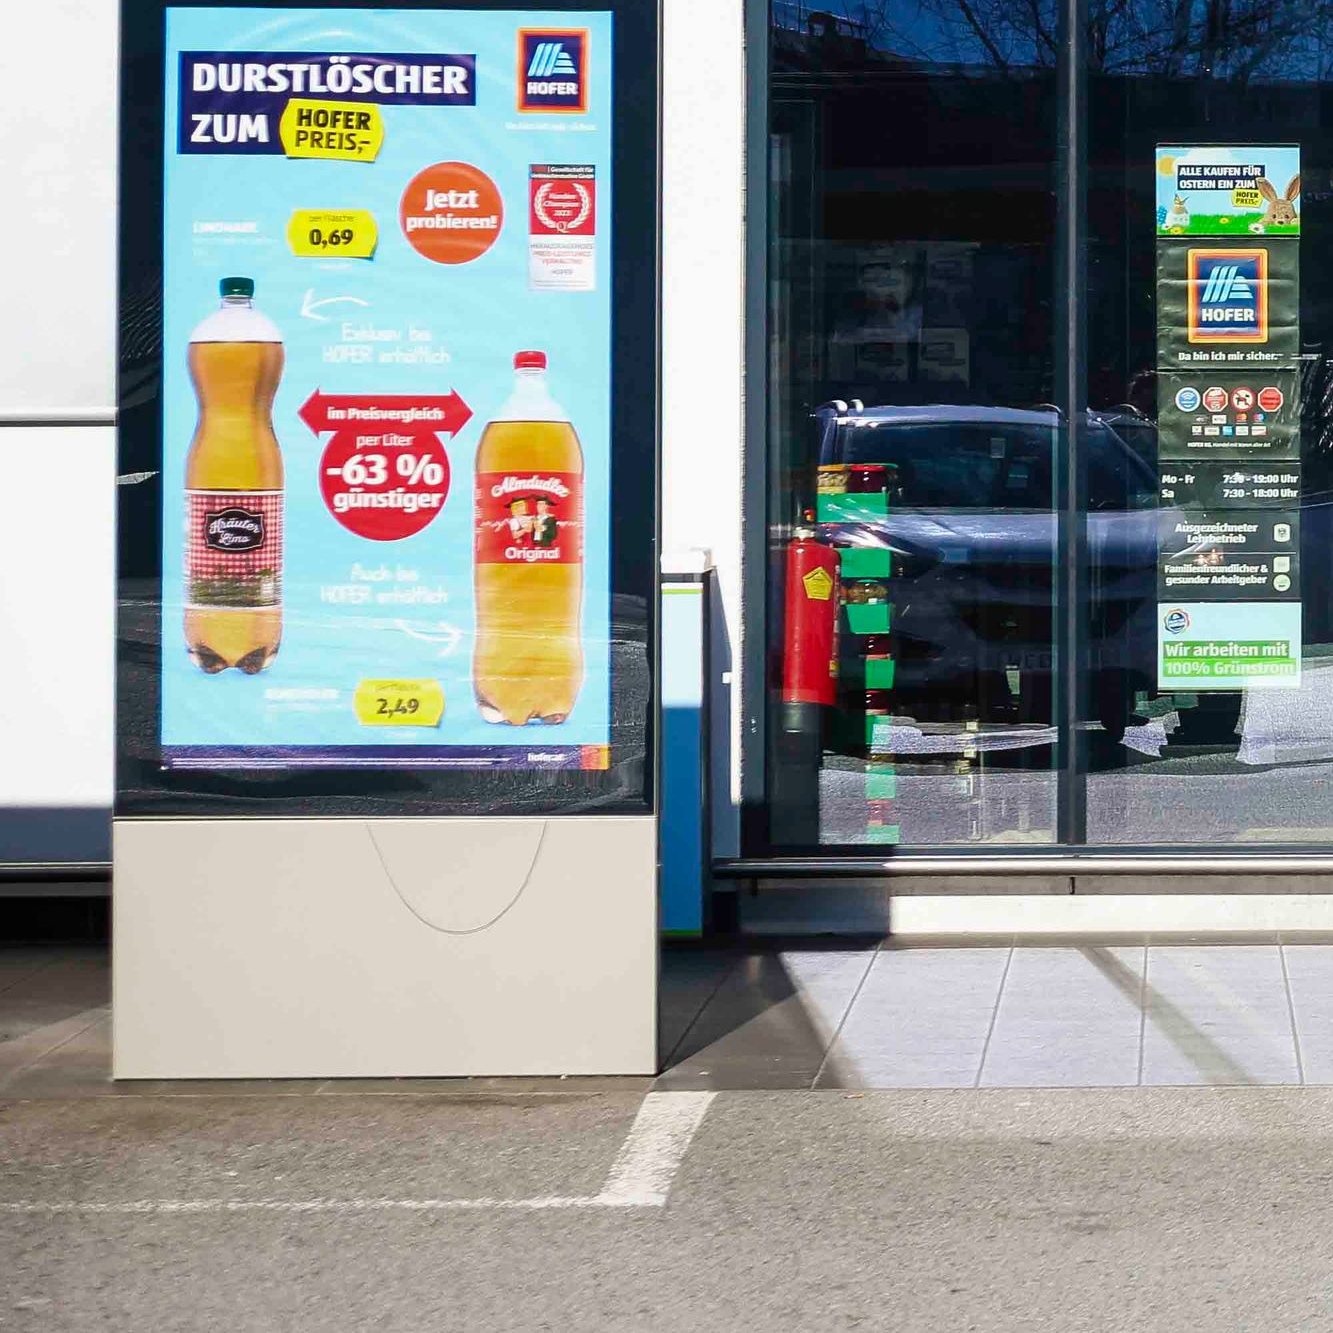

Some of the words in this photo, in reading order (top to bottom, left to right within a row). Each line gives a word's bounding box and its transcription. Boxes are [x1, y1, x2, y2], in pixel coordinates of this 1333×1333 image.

[192, 56, 468, 95] DURSTLÖSCHER
[527, 82, 578, 95] HOFER
[297, 108, 371, 131] HOFER
[191, 113, 270, 143] ZUM
[295, 131, 371, 155] PREIS,-
[1179, 167, 1201, 176] ALLE
[1203, 167, 1241, 176] KAUFEN
[1243, 165, 1261, 176] FÜR
[1179, 180, 1215, 189] OSTERN
[1218, 180, 1233, 189] EIN
[1235, 180, 1255, 189] ZUM
[425, 190, 479, 211] Jetzt
[406, 213, 498, 233] probieren!
[309, 228, 354, 248] 0,69
[1201, 308, 1255, 322] HOFER
[1178, 352, 1191, 361] Da
[1193, 352, 1209, 361] bin
[1211, 352, 1226, 361] ich
[1227, 352, 1245, 361] mir
[1246, 352, 1278, 361] sicher.
[327, 407, 344, 420] im
[346, 406, 445, 423] Preisvergleich
[356, 435, 379, 450] per
[382, 433, 414, 447] Liter
[326, 454, 389, 486] -63
[395, 454, 444, 486] %
[491, 475, 572, 498] Almdudler
[1161, 475, 1177, 484] Mo
[1185, 475, 1195, 484] Fr
[1223, 475, 1244, 484] 7:30
[1280, 475, 1299, 484] Uhr
[333, 488, 442, 513] günstiger
[1161, 489, 1175, 498] Sa
[1223, 489, 1244, 498] 7:30
[1252, 489, 1279, 498] 18:00
[1280, 489, 1299, 498] Uhr
[209, 517, 260, 534] Kräuter
[1175, 523, 1258, 534] Ausgezeichneter
[218, 532, 251, 545] Limo
[1187, 534, 1246, 543] Lehrbetrieb
[504, 546, 560, 561] Original
[1164, 564, 1259, 573] Familienfreundlicher
[1260, 565, 1268, 573] &
[1165, 577, 1210, 586] gesunder
[1211, 575, 1267, 586] Arbeitgeber
[1165, 643, 1189, 657] Wir
[1193, 642, 1259, 657] arbeiten
[1262, 642, 1288, 657] mit
[1167, 661, 1210, 675] 100%
[1214, 660, 1296, 675] Grünstrom
[376, 697, 420, 718] 2,49
